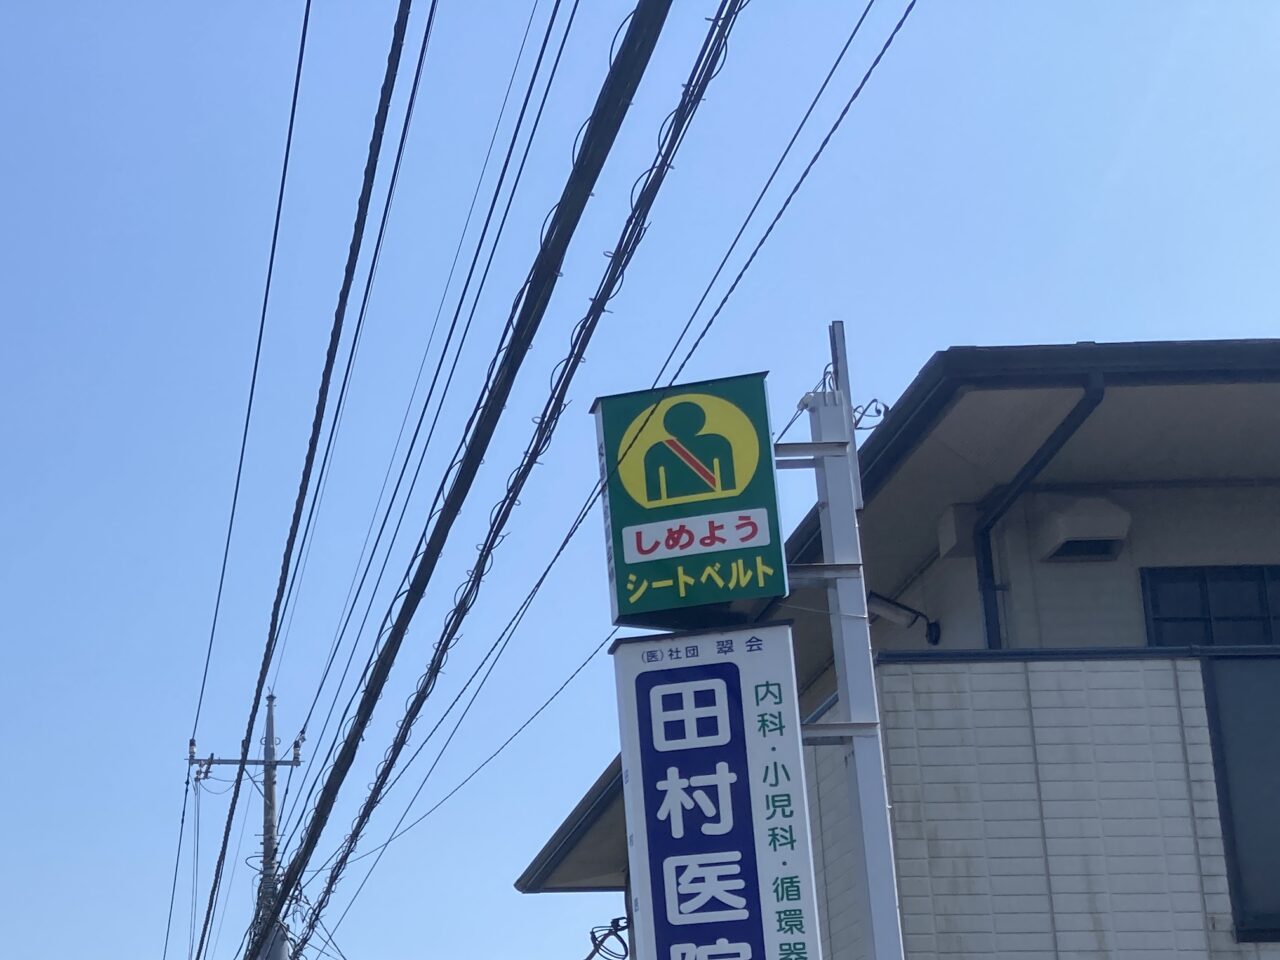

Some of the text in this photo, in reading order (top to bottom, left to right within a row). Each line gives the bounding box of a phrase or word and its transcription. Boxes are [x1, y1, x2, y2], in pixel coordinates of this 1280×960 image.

[635, 515, 758, 555] しめよう
[626, 555, 774, 604] シートベルト
